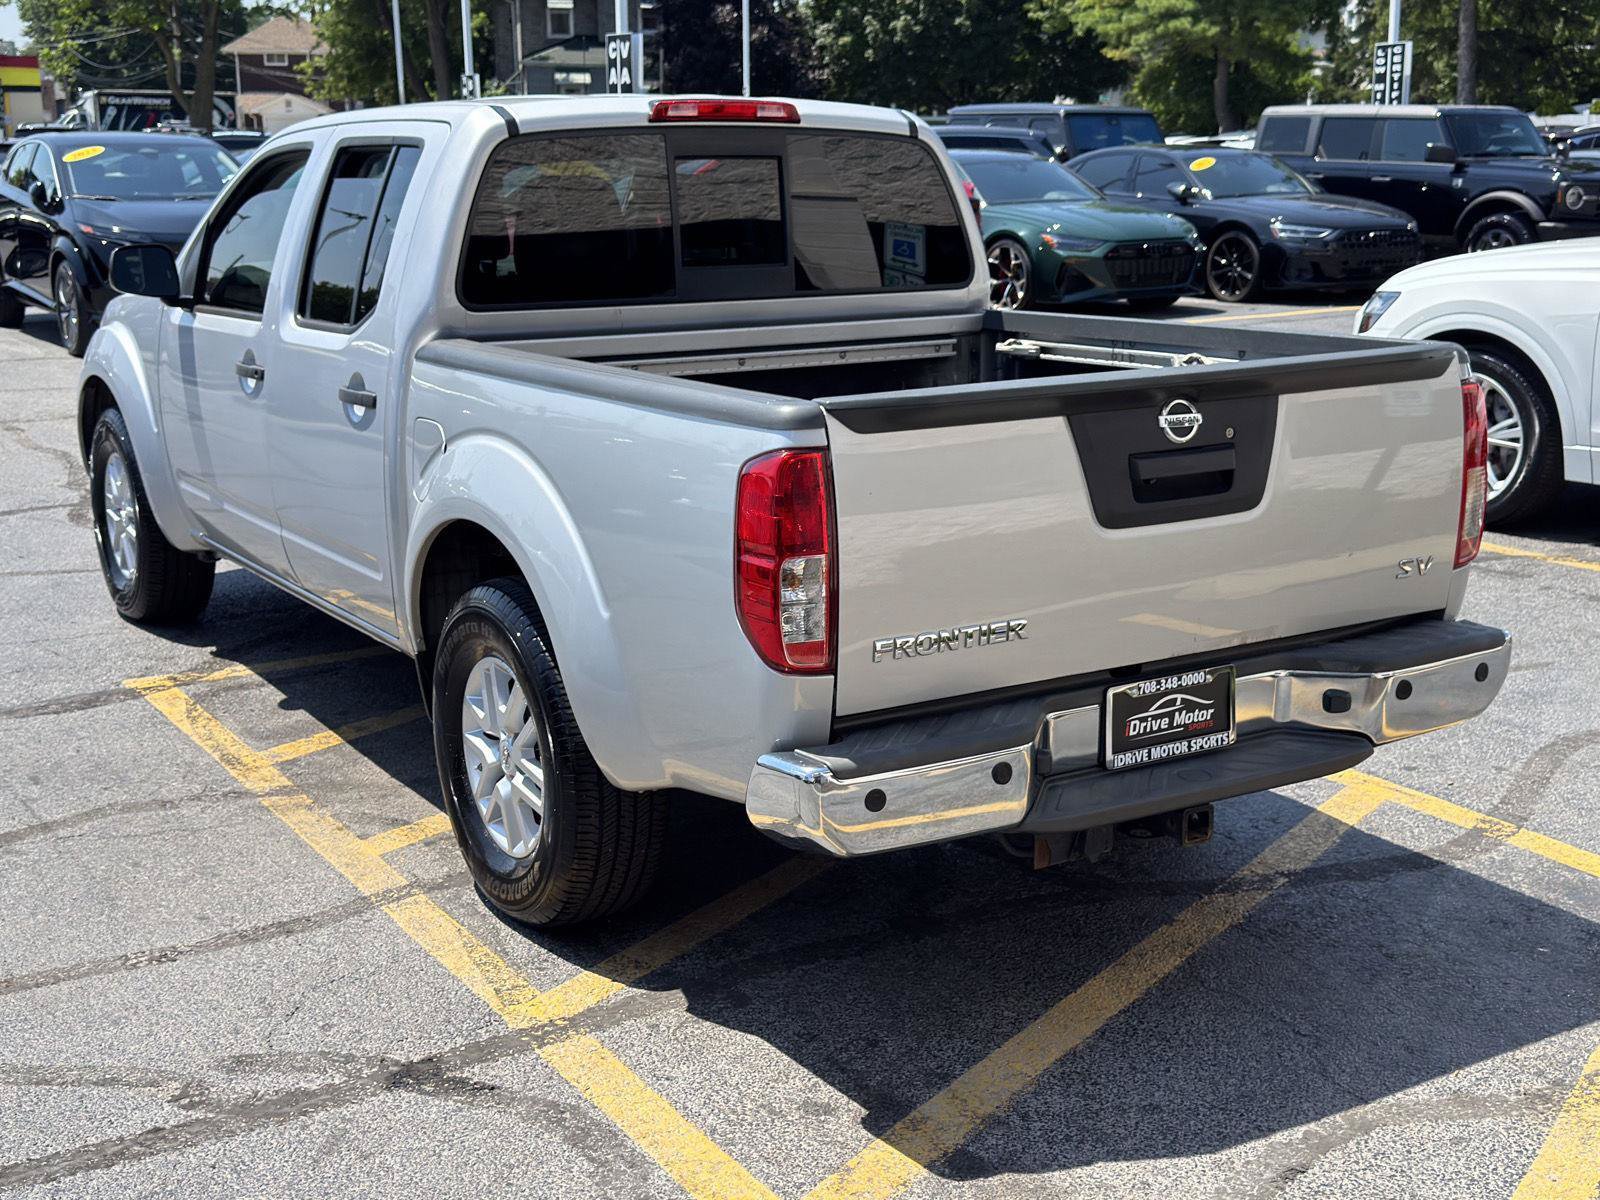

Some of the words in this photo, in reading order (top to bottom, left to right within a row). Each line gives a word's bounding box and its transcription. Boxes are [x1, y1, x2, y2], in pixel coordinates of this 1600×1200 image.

[1164, 415, 1199, 425] NISSAN
[1395, 555, 1434, 579] SV
[872, 617, 1029, 663] FRONTIER
[1138, 671, 1206, 695] 708-348-0000
[1173, 708, 1215, 727] Motor
[1187, 720, 1214, 732] SPORTS
[1151, 742, 1189, 760] MOTOR
[1190, 733, 1229, 752] SPORTS
